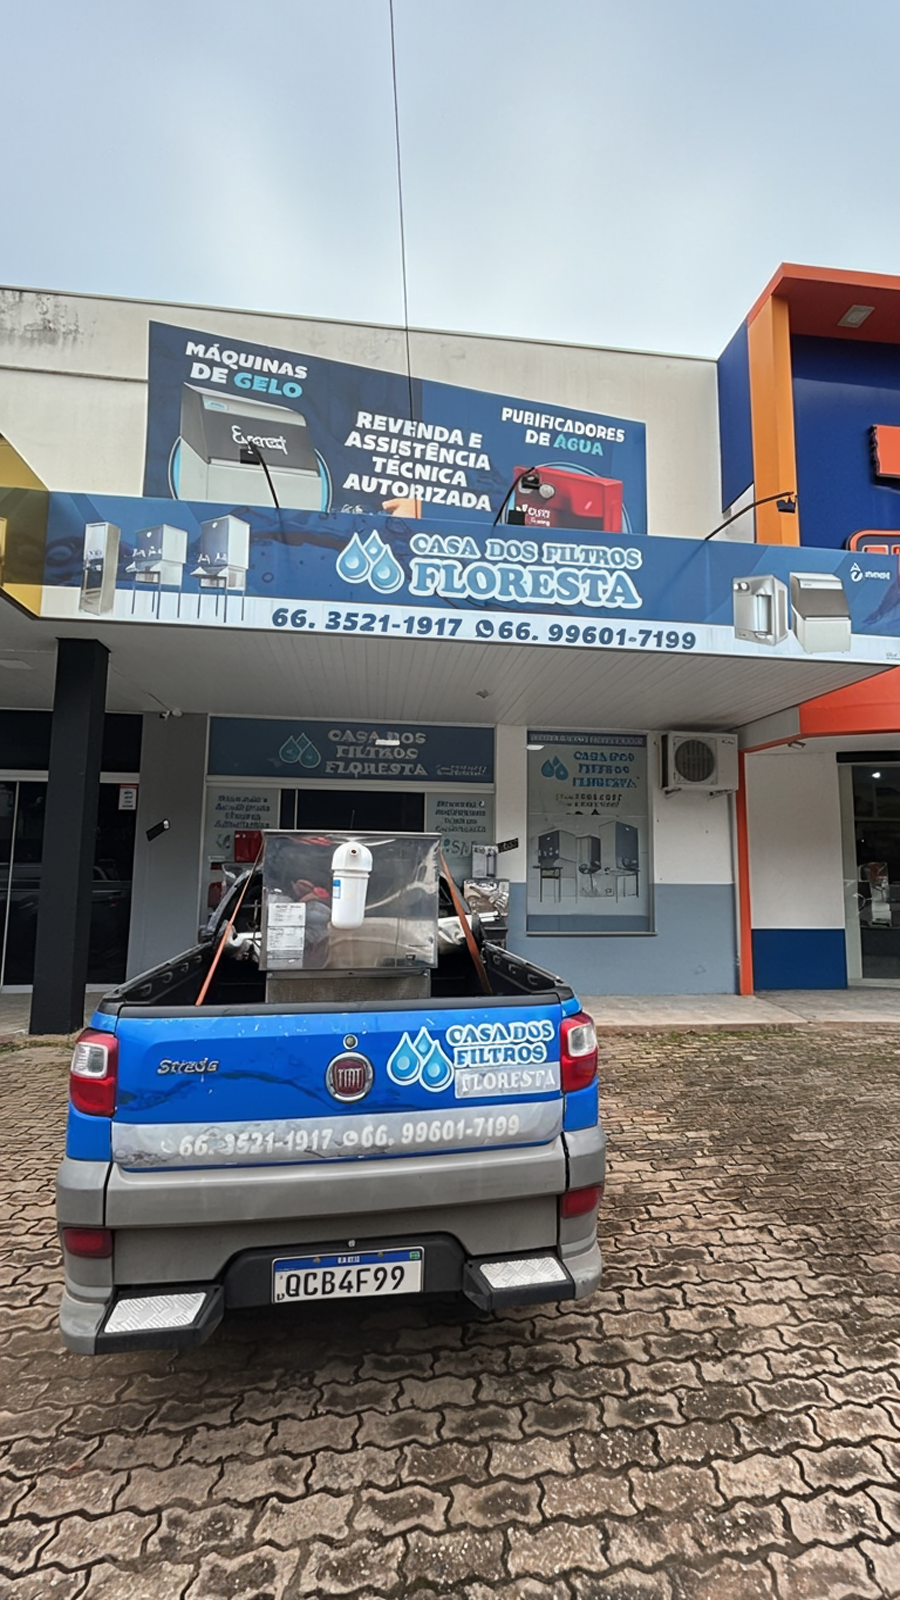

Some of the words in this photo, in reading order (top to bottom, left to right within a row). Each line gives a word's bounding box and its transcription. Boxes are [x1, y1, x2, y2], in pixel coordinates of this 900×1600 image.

[185, 341, 307, 379] MÁQUINAS
[190, 362, 229, 384] DE
[234, 372, 303, 398] GELO
[356, 411, 464, 446] REVENDA
[469, 432, 483, 448] E
[525, 429, 551, 446] DE
[344, 431, 491, 471] ASSISTÊNCIA
[372, 454, 467, 487] TÉCNICA
[342, 473, 492, 512] AUTORIZADA
[410, 533, 481, 559] CASA
[485, 538, 538, 562] DOS
[543, 542, 642, 569] FILTROS
[409, 558, 643, 609] FLORESTA
[272, 608, 315, 628] 66.
[325, 611, 463, 636] 3521-1917
[498, 621, 538, 641] 66.
[548, 624, 696, 650] 99601-7199
[328, 729, 380, 743] CASA
[453, 1042, 547, 1068] FILTROS
[461, 1069, 556, 1092] FLORESTA
[179, 1134, 215, 1156] 66.
[222, 1128, 333, 1155] 3521-1917
[361, 1125, 394, 1147] 66.
[401, 1115, 520, 1144] 99601-7199
[285, 1266, 405, 1297] QCB4F99
